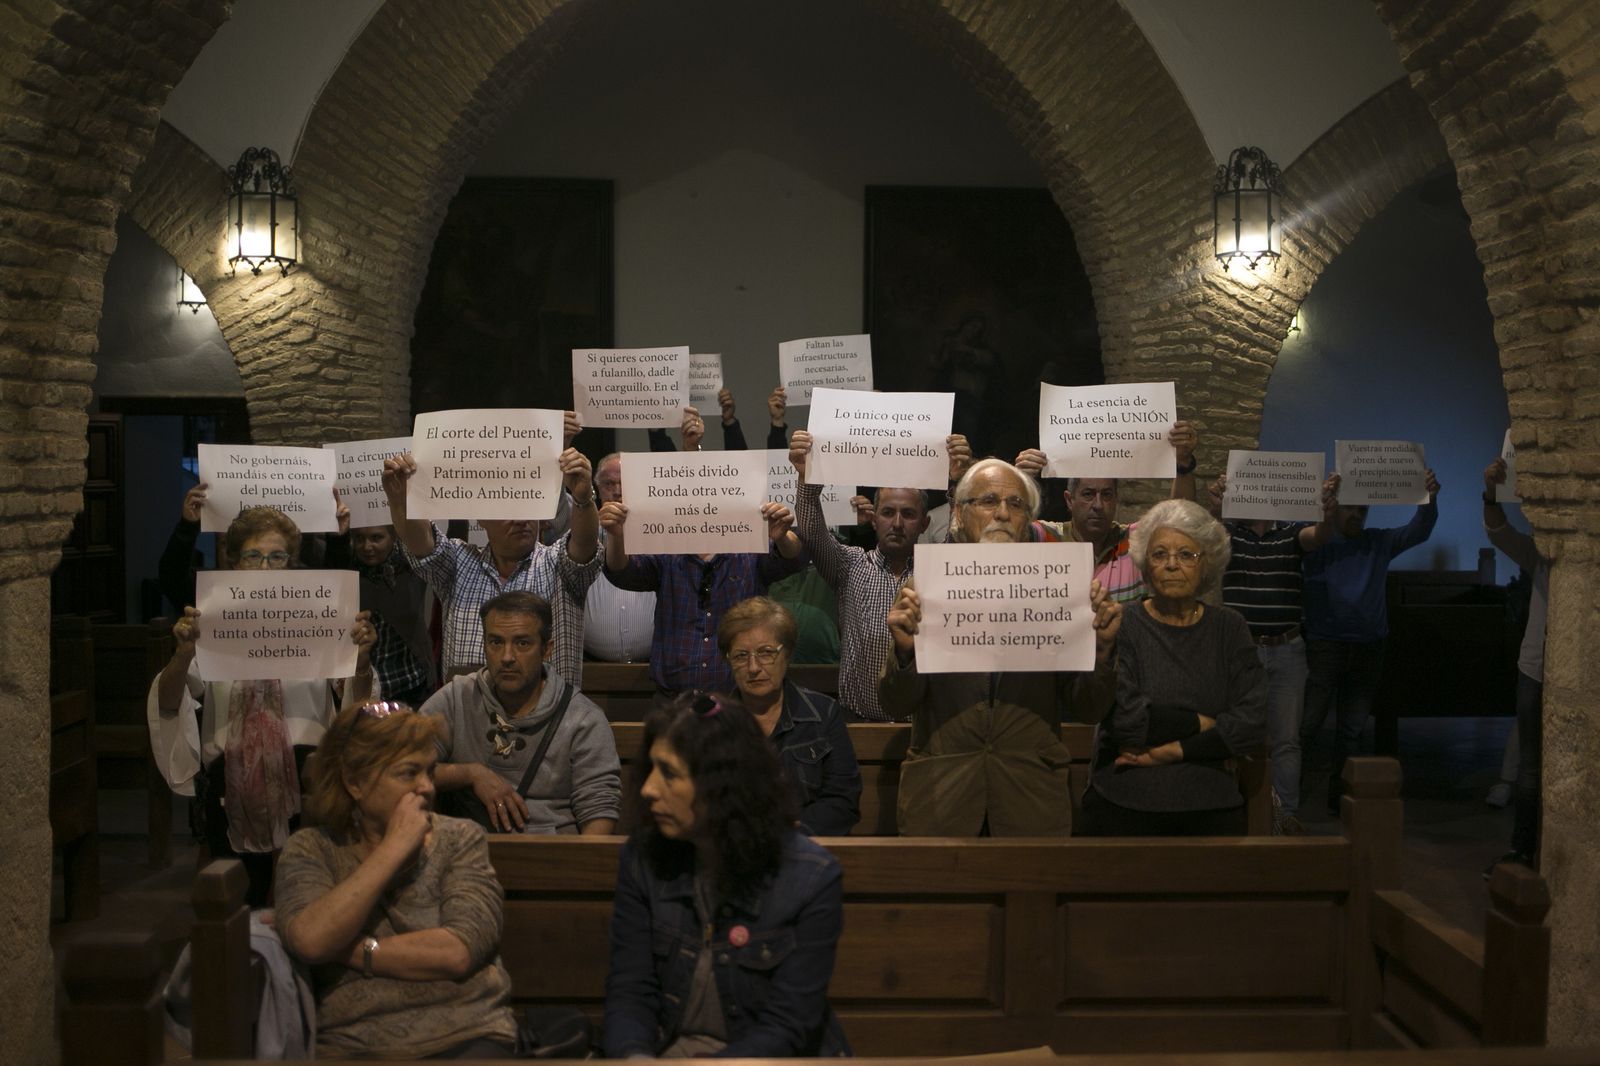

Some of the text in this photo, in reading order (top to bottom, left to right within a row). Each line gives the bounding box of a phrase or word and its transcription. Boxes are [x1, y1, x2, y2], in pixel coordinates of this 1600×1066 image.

[806, 339, 843, 349] Faltan las
[587, 353, 678, 365] Si quieres conocer
[794, 352, 857, 362] infraestructuras
[601, 368, 645, 379] fulanillo,
[648, 367, 674, 377] dadle
[788, 374, 866, 387] entonces todo sería
[589, 381, 678, 395] un carguillo. En el
[588, 396, 680, 408] Ayuntamiento hay
[1069, 396, 1147, 408] La esencia de
[605, 412, 664, 423] unos pocos.
[835, 409, 931, 423] Lo único que os
[1050, 410, 1168, 425] Ronda es la UNIÓN
[427, 426, 553, 440] El corte del Puente,
[849, 426, 912, 437] interesa es
[1060, 430, 1161, 443] que representa su
[443, 446, 531, 462] ni preserva el
[821, 442, 939, 458] el sillón y el sueldo.
[1091, 447, 1133, 458] Puente.
[1348, 444, 1382, 452] Vuestras
[230, 455, 311, 468] No gobernáis,
[342, 454, 354, 463] La
[1246, 458, 1279, 467] Actuáis
[1353, 456, 1375, 464] abren
[217, 471, 325, 480] mandáis en contra
[434, 467, 541, 478] Patrimonio ni el
[653, 465, 738, 478] Habéis divido
[1269, 471, 1316, 480] insensibles
[1359, 468, 1400, 477] precipicio,
[339, 486, 349, 495] ni
[784, 480, 791, 489] el
[1235, 484, 1240, 492] y
[1261, 484, 1288, 492] tratáis
[241, 485, 305, 499] del pueblo,
[430, 486, 545, 499] Medio Ambiente.
[648, 485, 744, 497] Ronda otra vez,
[1368, 491, 1399, 499] aduana.
[368, 499, 378, 508] ni
[1231, 495, 1318, 506] súbditos ignorantes.
[675, 503, 718, 516] más de
[643, 521, 753, 536] 200 años después.
[945, 561, 1070, 578] Lucharemos por
[229, 585, 331, 600] Ya está bien de
[947, 583, 1068, 600] nuestra libertad
[223, 606, 337, 624] tanta torpeza, de
[943, 607, 1072, 627] y por una Ronda
[213, 624, 345, 640] tanta obstinación y
[951, 632, 1064, 649] unida siempre.
[248, 644, 311, 658] soberbia.
